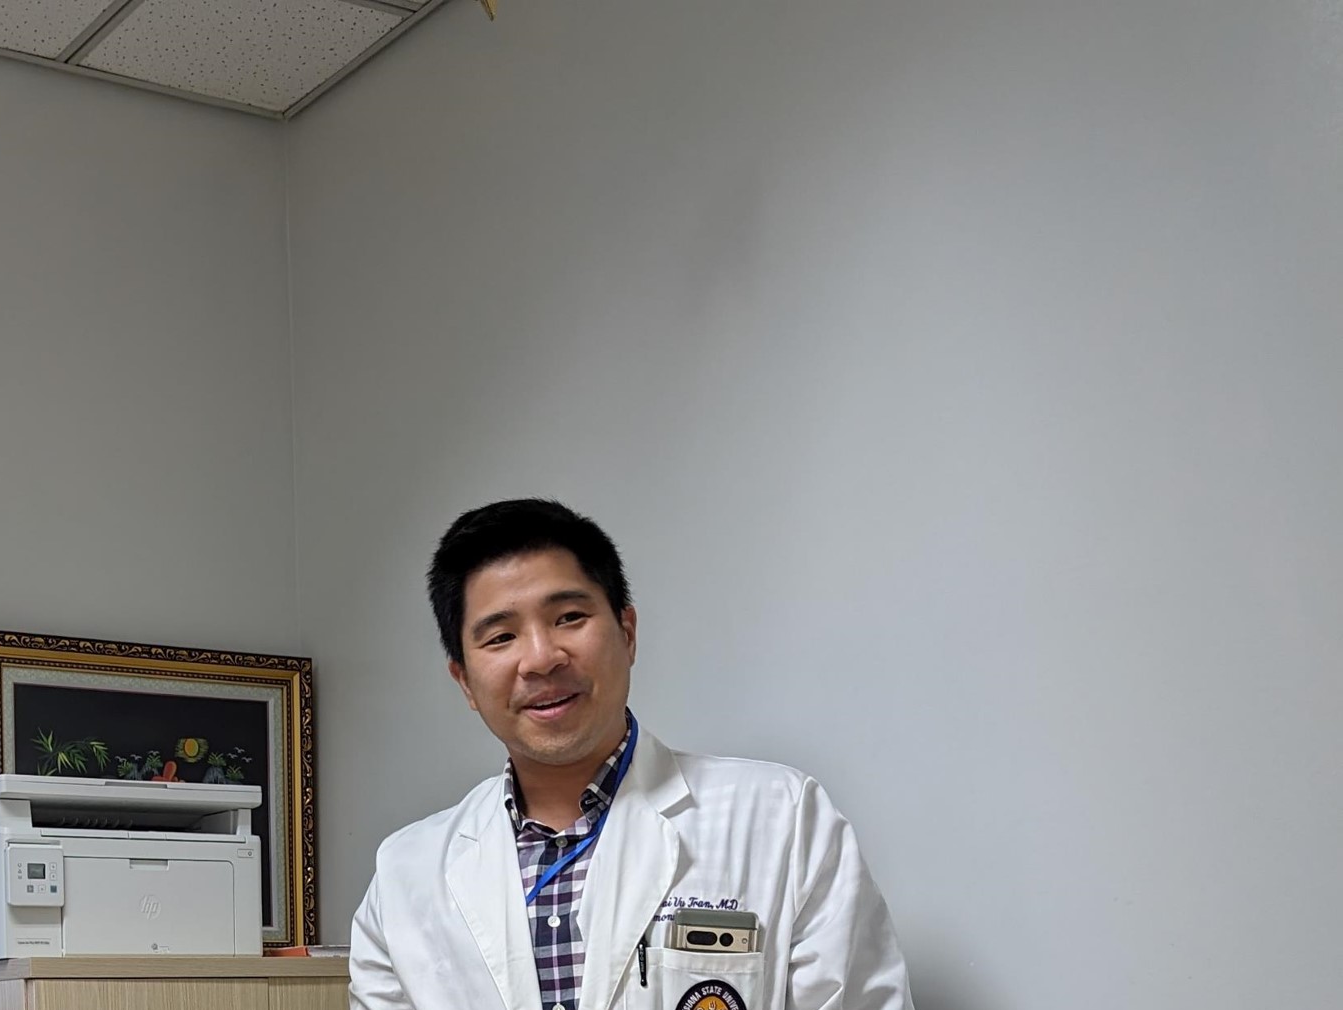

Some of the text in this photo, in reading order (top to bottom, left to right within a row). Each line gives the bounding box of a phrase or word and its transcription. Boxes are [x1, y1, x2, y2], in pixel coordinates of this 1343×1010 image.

[140, 895, 159, 920] hp
[673, 896, 686, 908] Vu
[688, 896, 714, 909] Tran,
[701, 985, 723, 996] STATE
